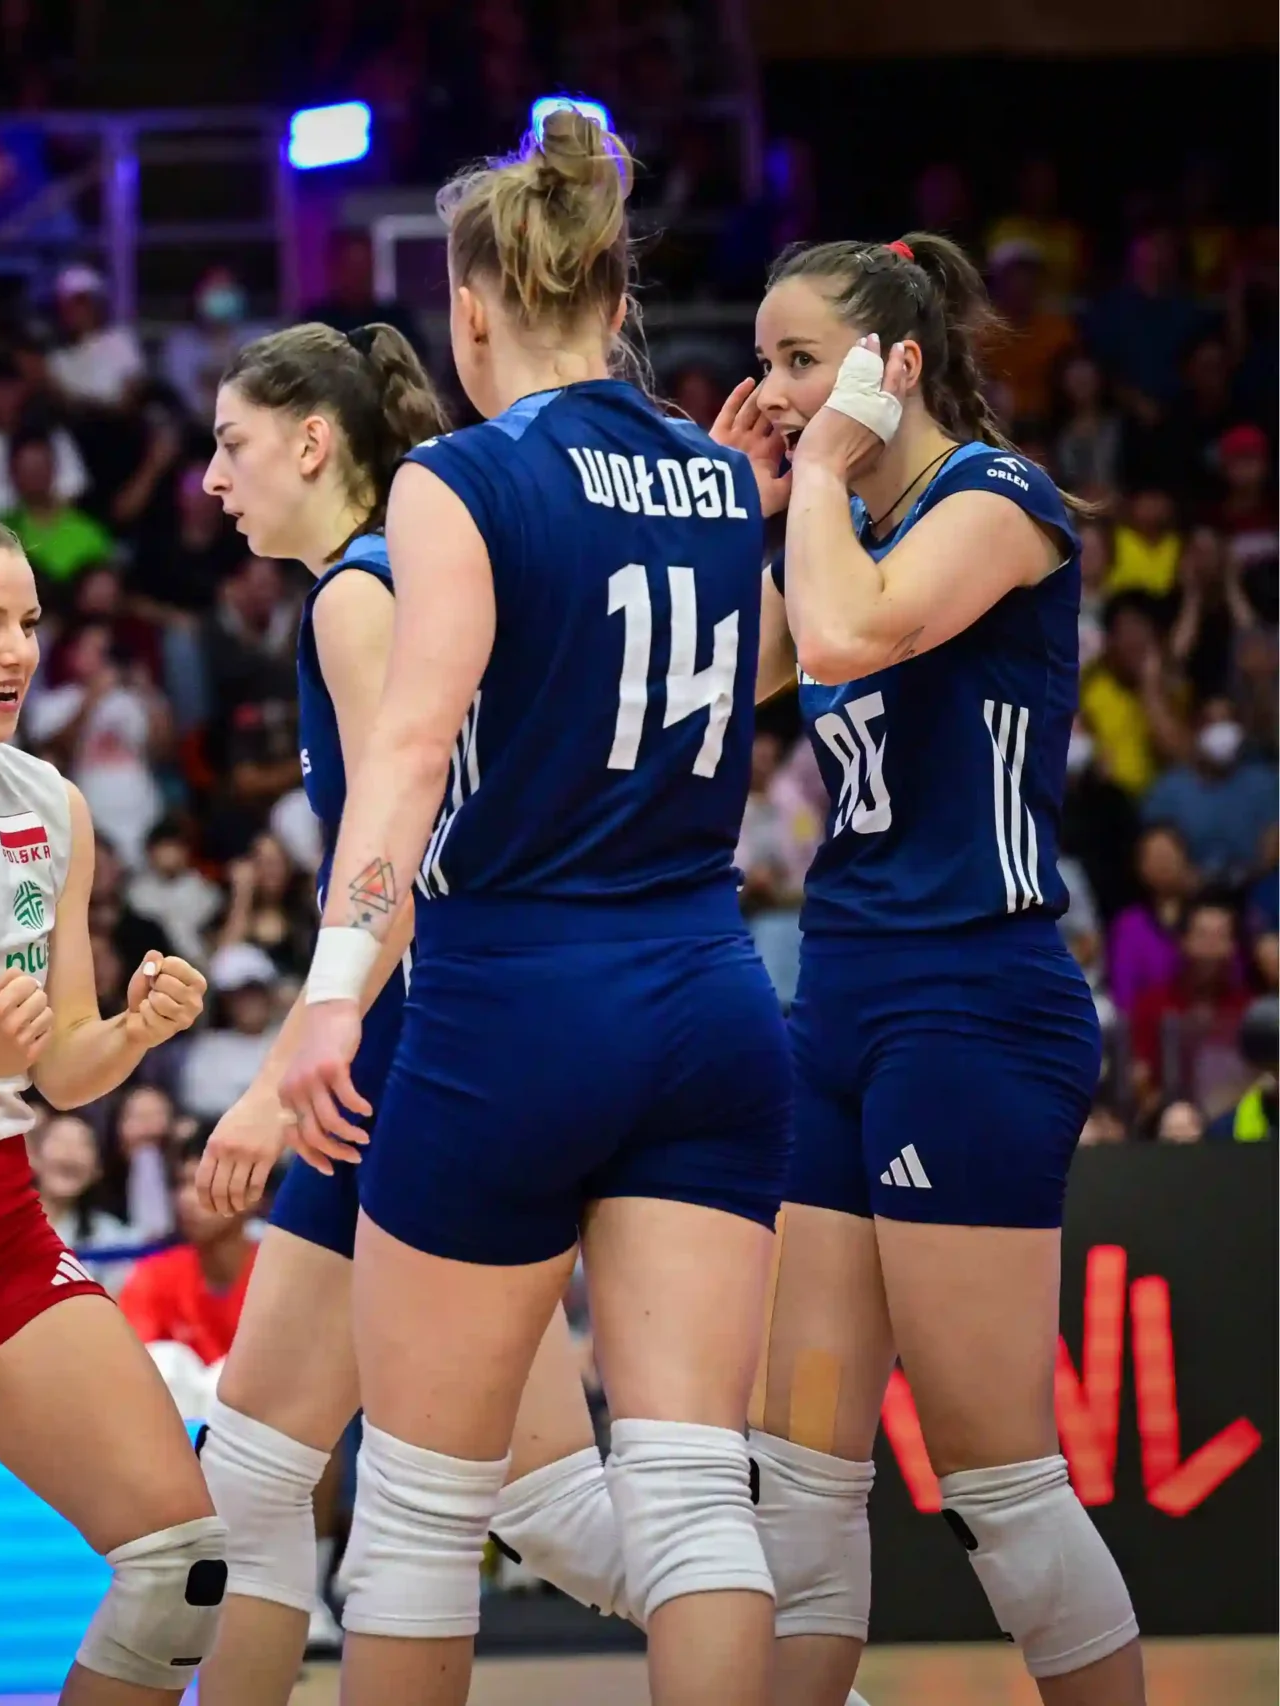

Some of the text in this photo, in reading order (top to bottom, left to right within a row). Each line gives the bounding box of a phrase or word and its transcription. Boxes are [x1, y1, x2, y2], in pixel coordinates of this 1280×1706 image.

[568, 447, 748, 519] WOŁOSZ
[986, 468, 1029, 491] ORLEN
[607, 563, 739, 778] 14
